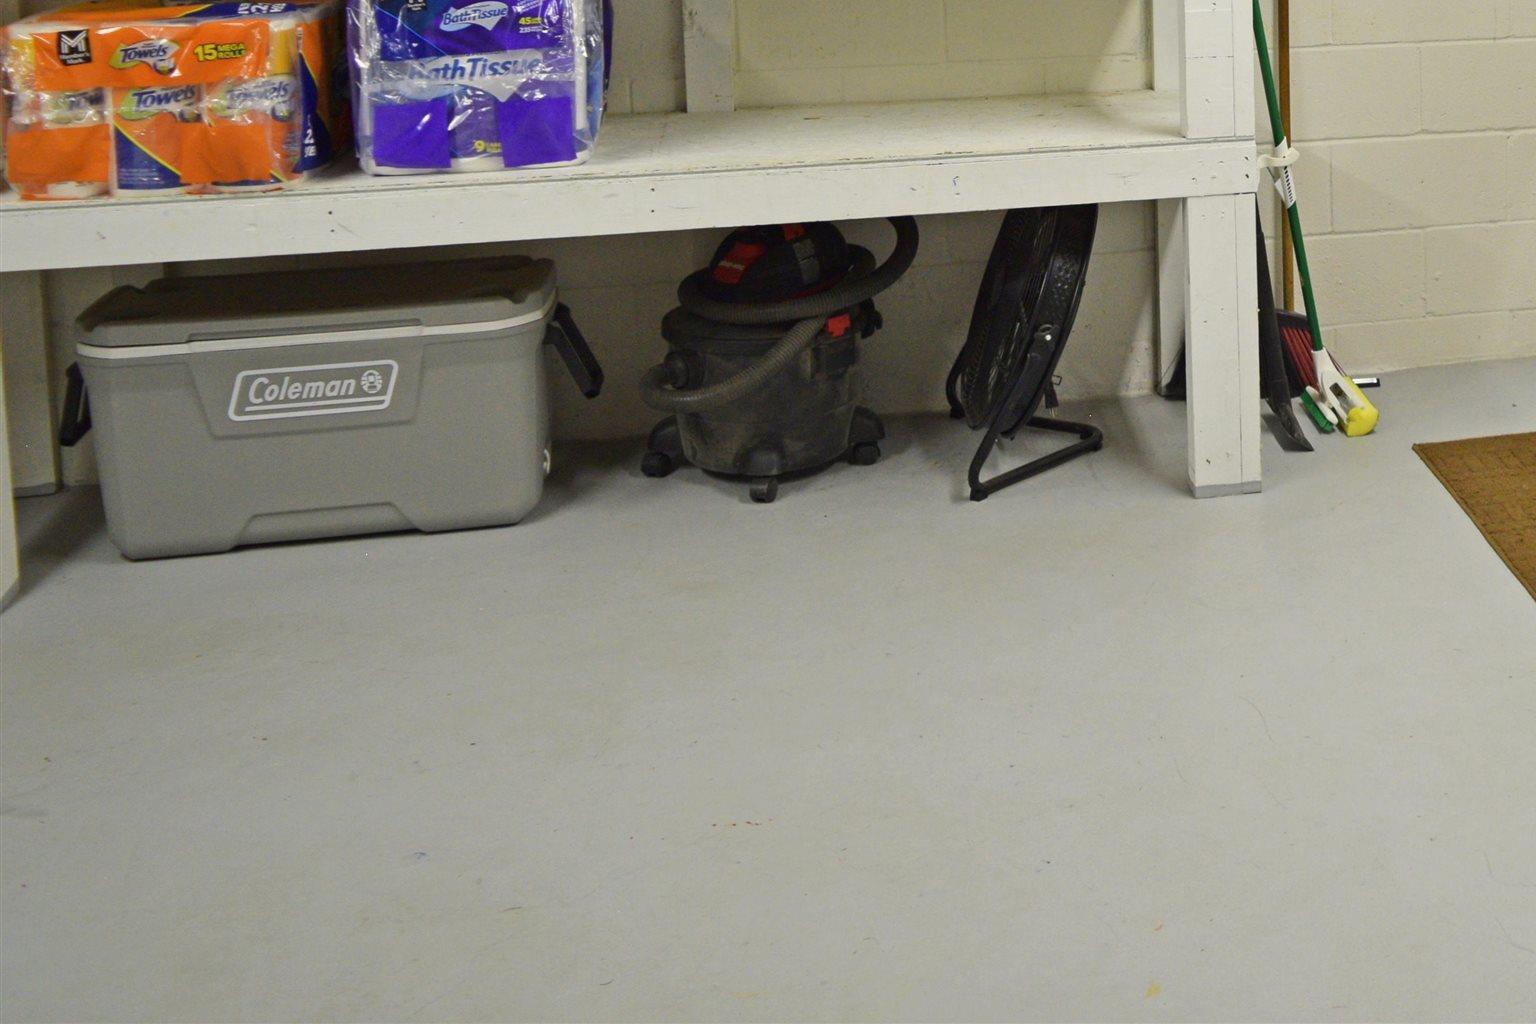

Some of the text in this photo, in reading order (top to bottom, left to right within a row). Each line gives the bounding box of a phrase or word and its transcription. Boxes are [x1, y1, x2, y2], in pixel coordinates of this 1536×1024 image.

[119, 44, 169, 63] Towels
[193, 43, 218, 61] 15
[132, 85, 197, 112] Towels
[250, 376, 356, 404] Coleman
